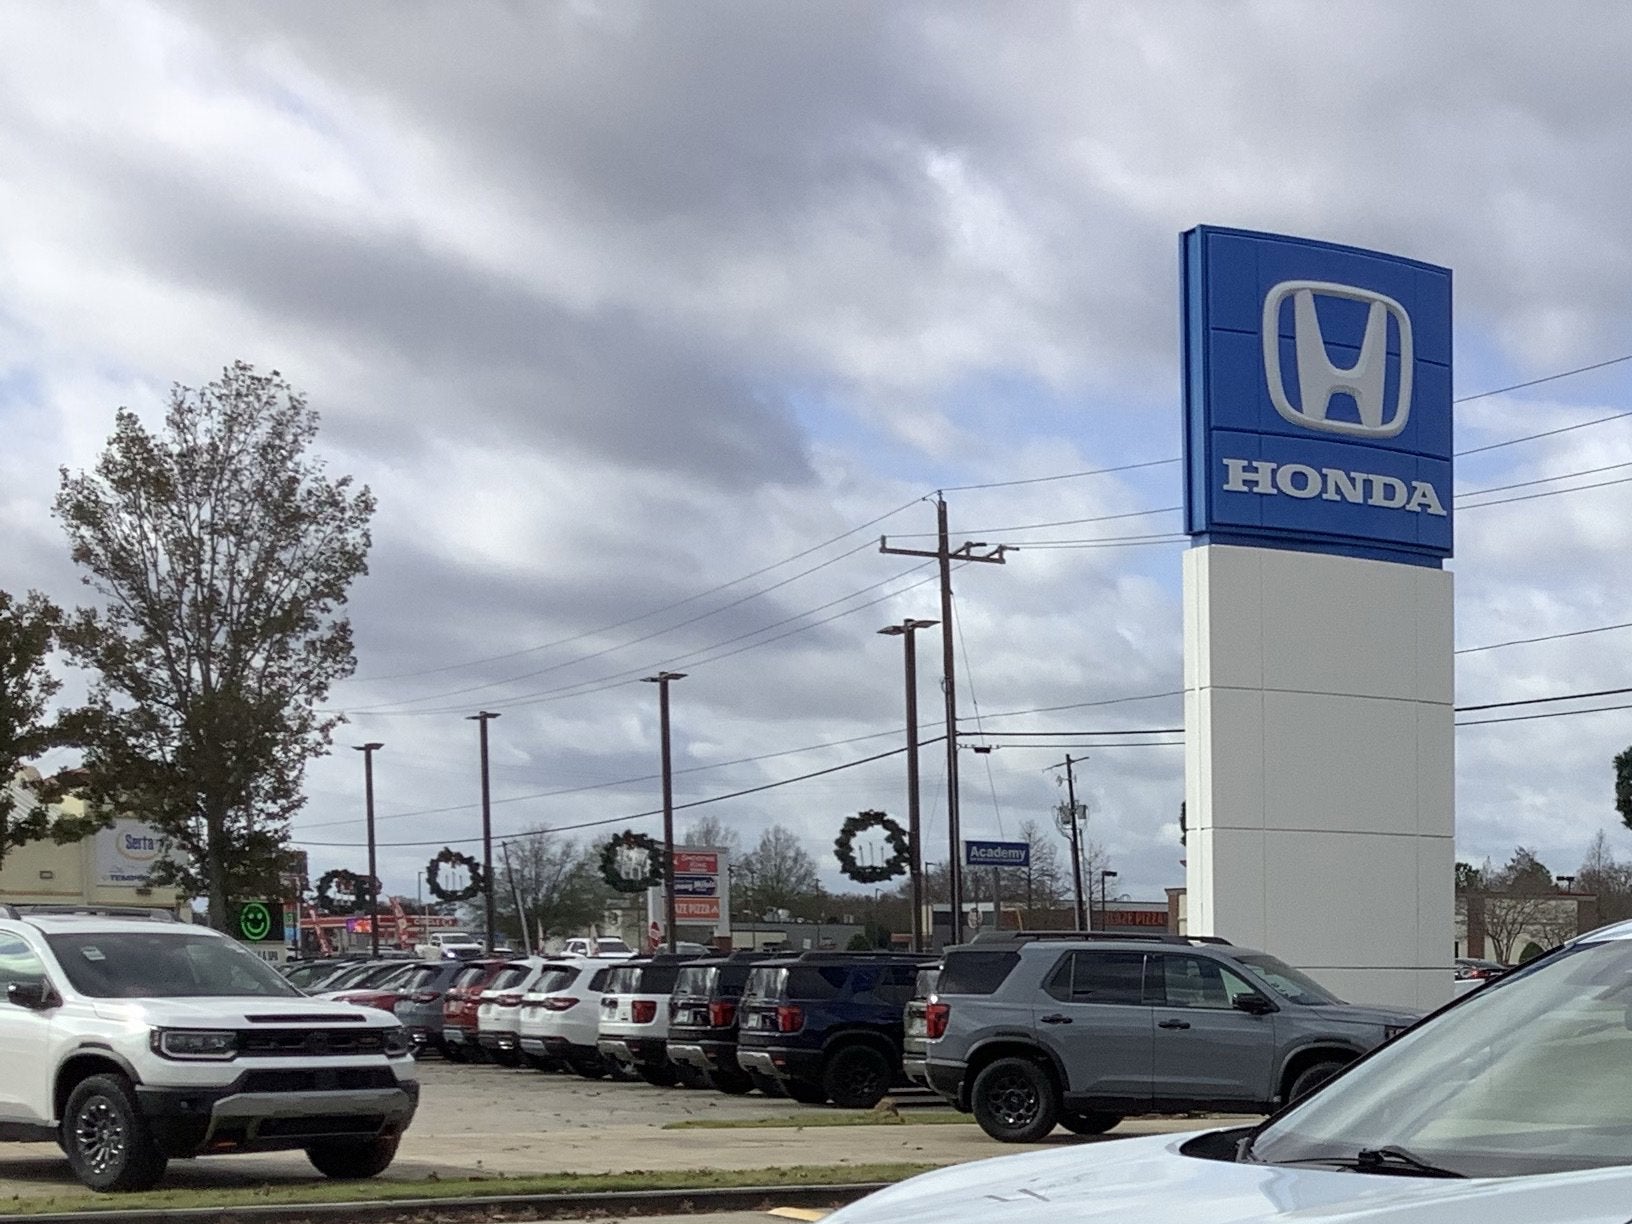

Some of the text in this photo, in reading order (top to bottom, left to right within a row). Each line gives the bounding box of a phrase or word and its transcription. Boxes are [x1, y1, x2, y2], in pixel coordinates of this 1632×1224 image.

[1222, 458, 1447, 516] HONDA
[125, 834, 154, 851] Serta
[970, 846, 1026, 862] Academy
